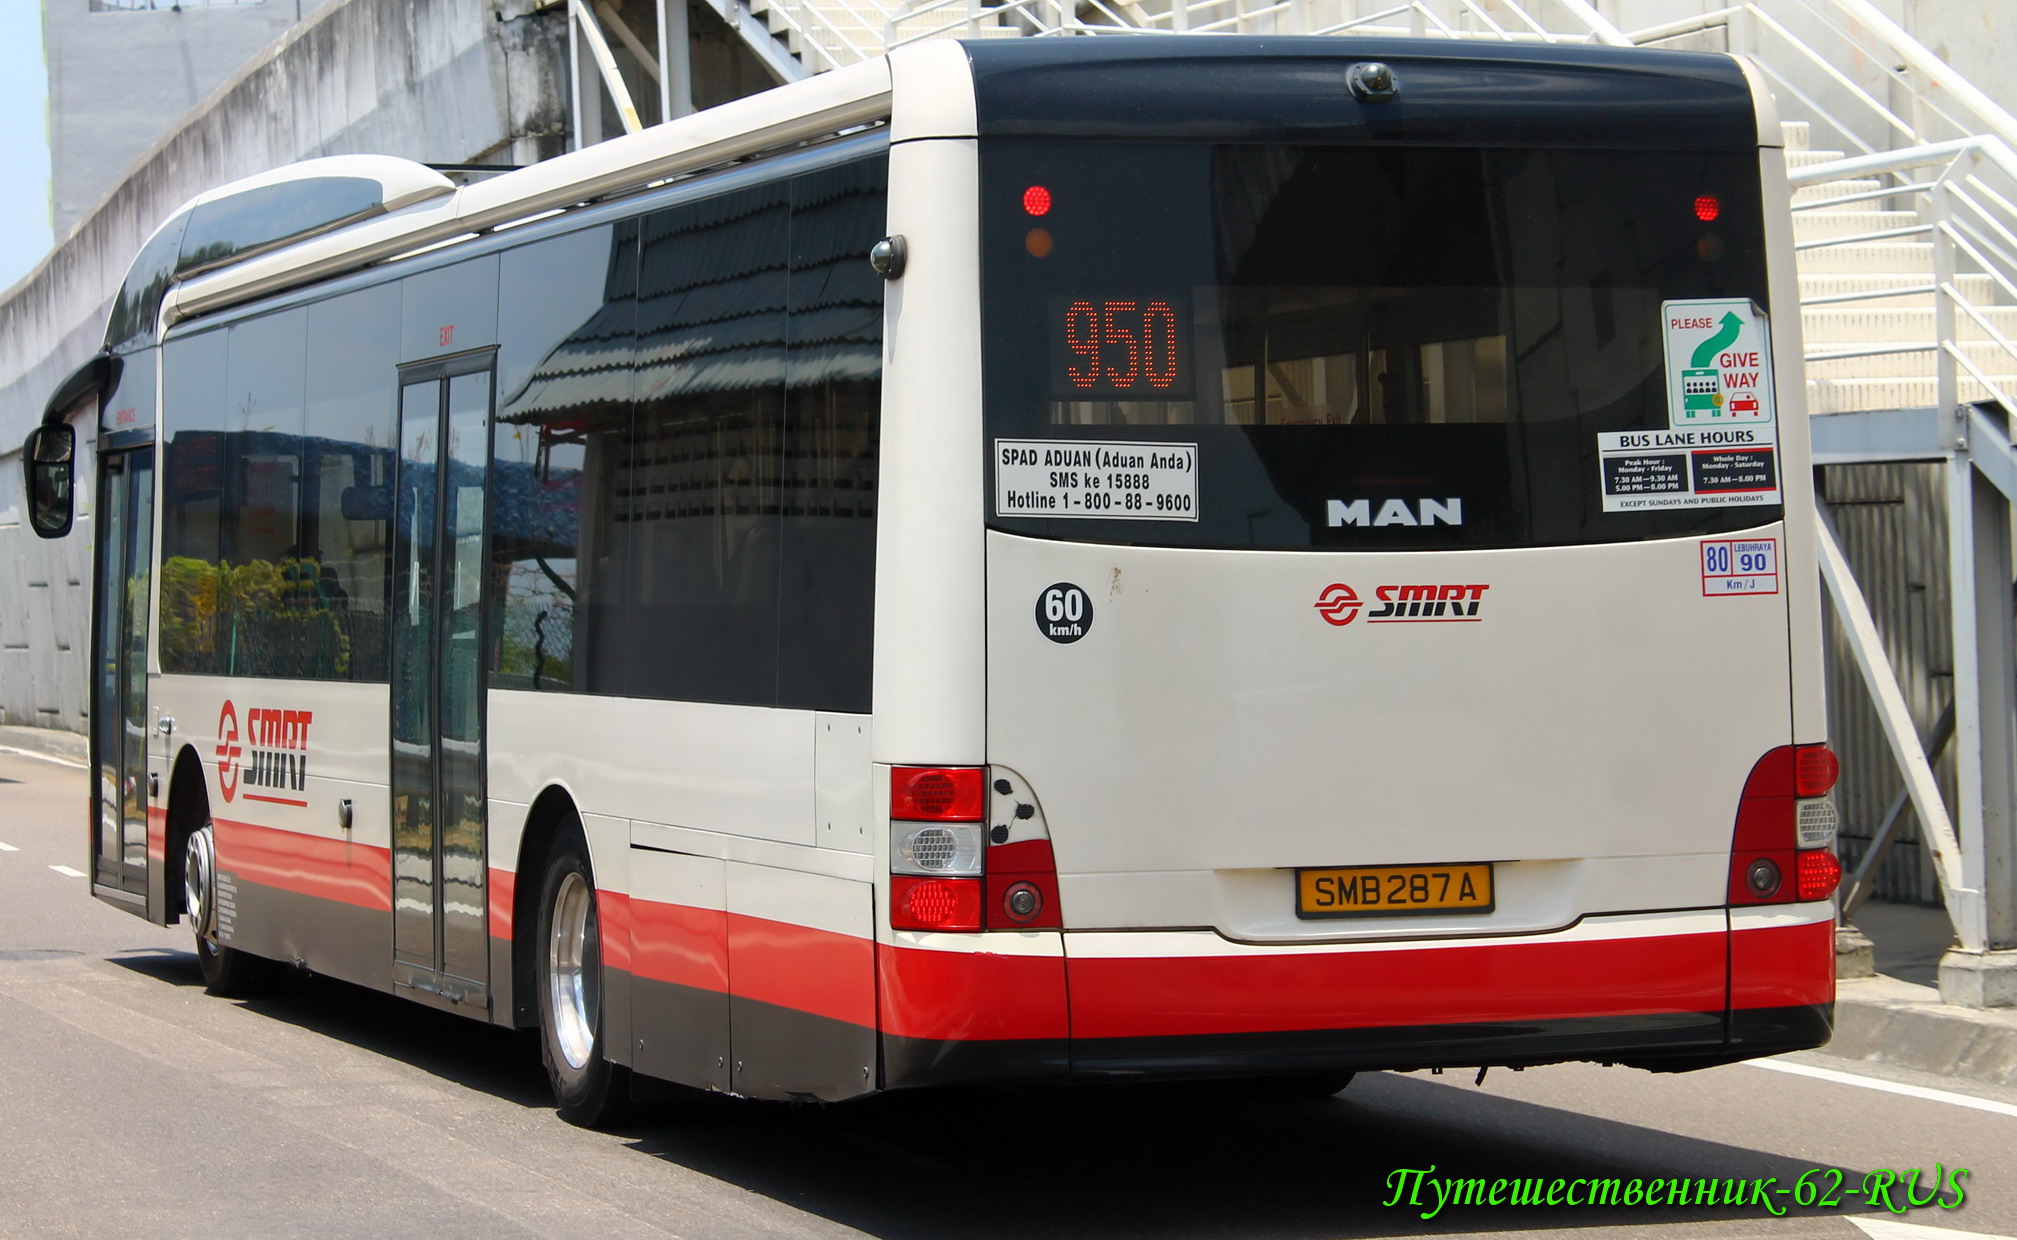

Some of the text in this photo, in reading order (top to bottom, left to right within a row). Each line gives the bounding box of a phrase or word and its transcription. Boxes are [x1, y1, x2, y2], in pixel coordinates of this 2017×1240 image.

[1671, 318, 1712, 329] PLEASE
[439, 325, 454, 346] EXIT
[1066, 301, 1177, 388] 950
[1720, 352, 1759, 368] GIVE
[1723, 372, 1759, 388] WAY
[1620, 430, 1754, 447] BUS LANE HOURS
[1002, 447, 1192, 473] SPAD ADUAN (Aduan Anda)
[1651, 465, 1672, 473] Friday
[1702, 462, 1729, 470] Monday
[1050, 472, 1150, 490] SMS ke 15888
[1614, 476, 1630, 484] 7.30
[1007, 490, 1056, 509] Hotline
[1728, 495, 1764, 503] HOLIDAYS
[1327, 498, 1462, 527] MAN
[1734, 543, 1772, 552] LEBUHRAYA
[1707, 546, 1728, 572] 80
[1740, 553, 1766, 571] 90
[1045, 588, 1083, 622] 60
[1368, 584, 1490, 617] SMRT
[1049, 623, 1082, 636] km/h
[243, 708, 312, 791] SMRT
